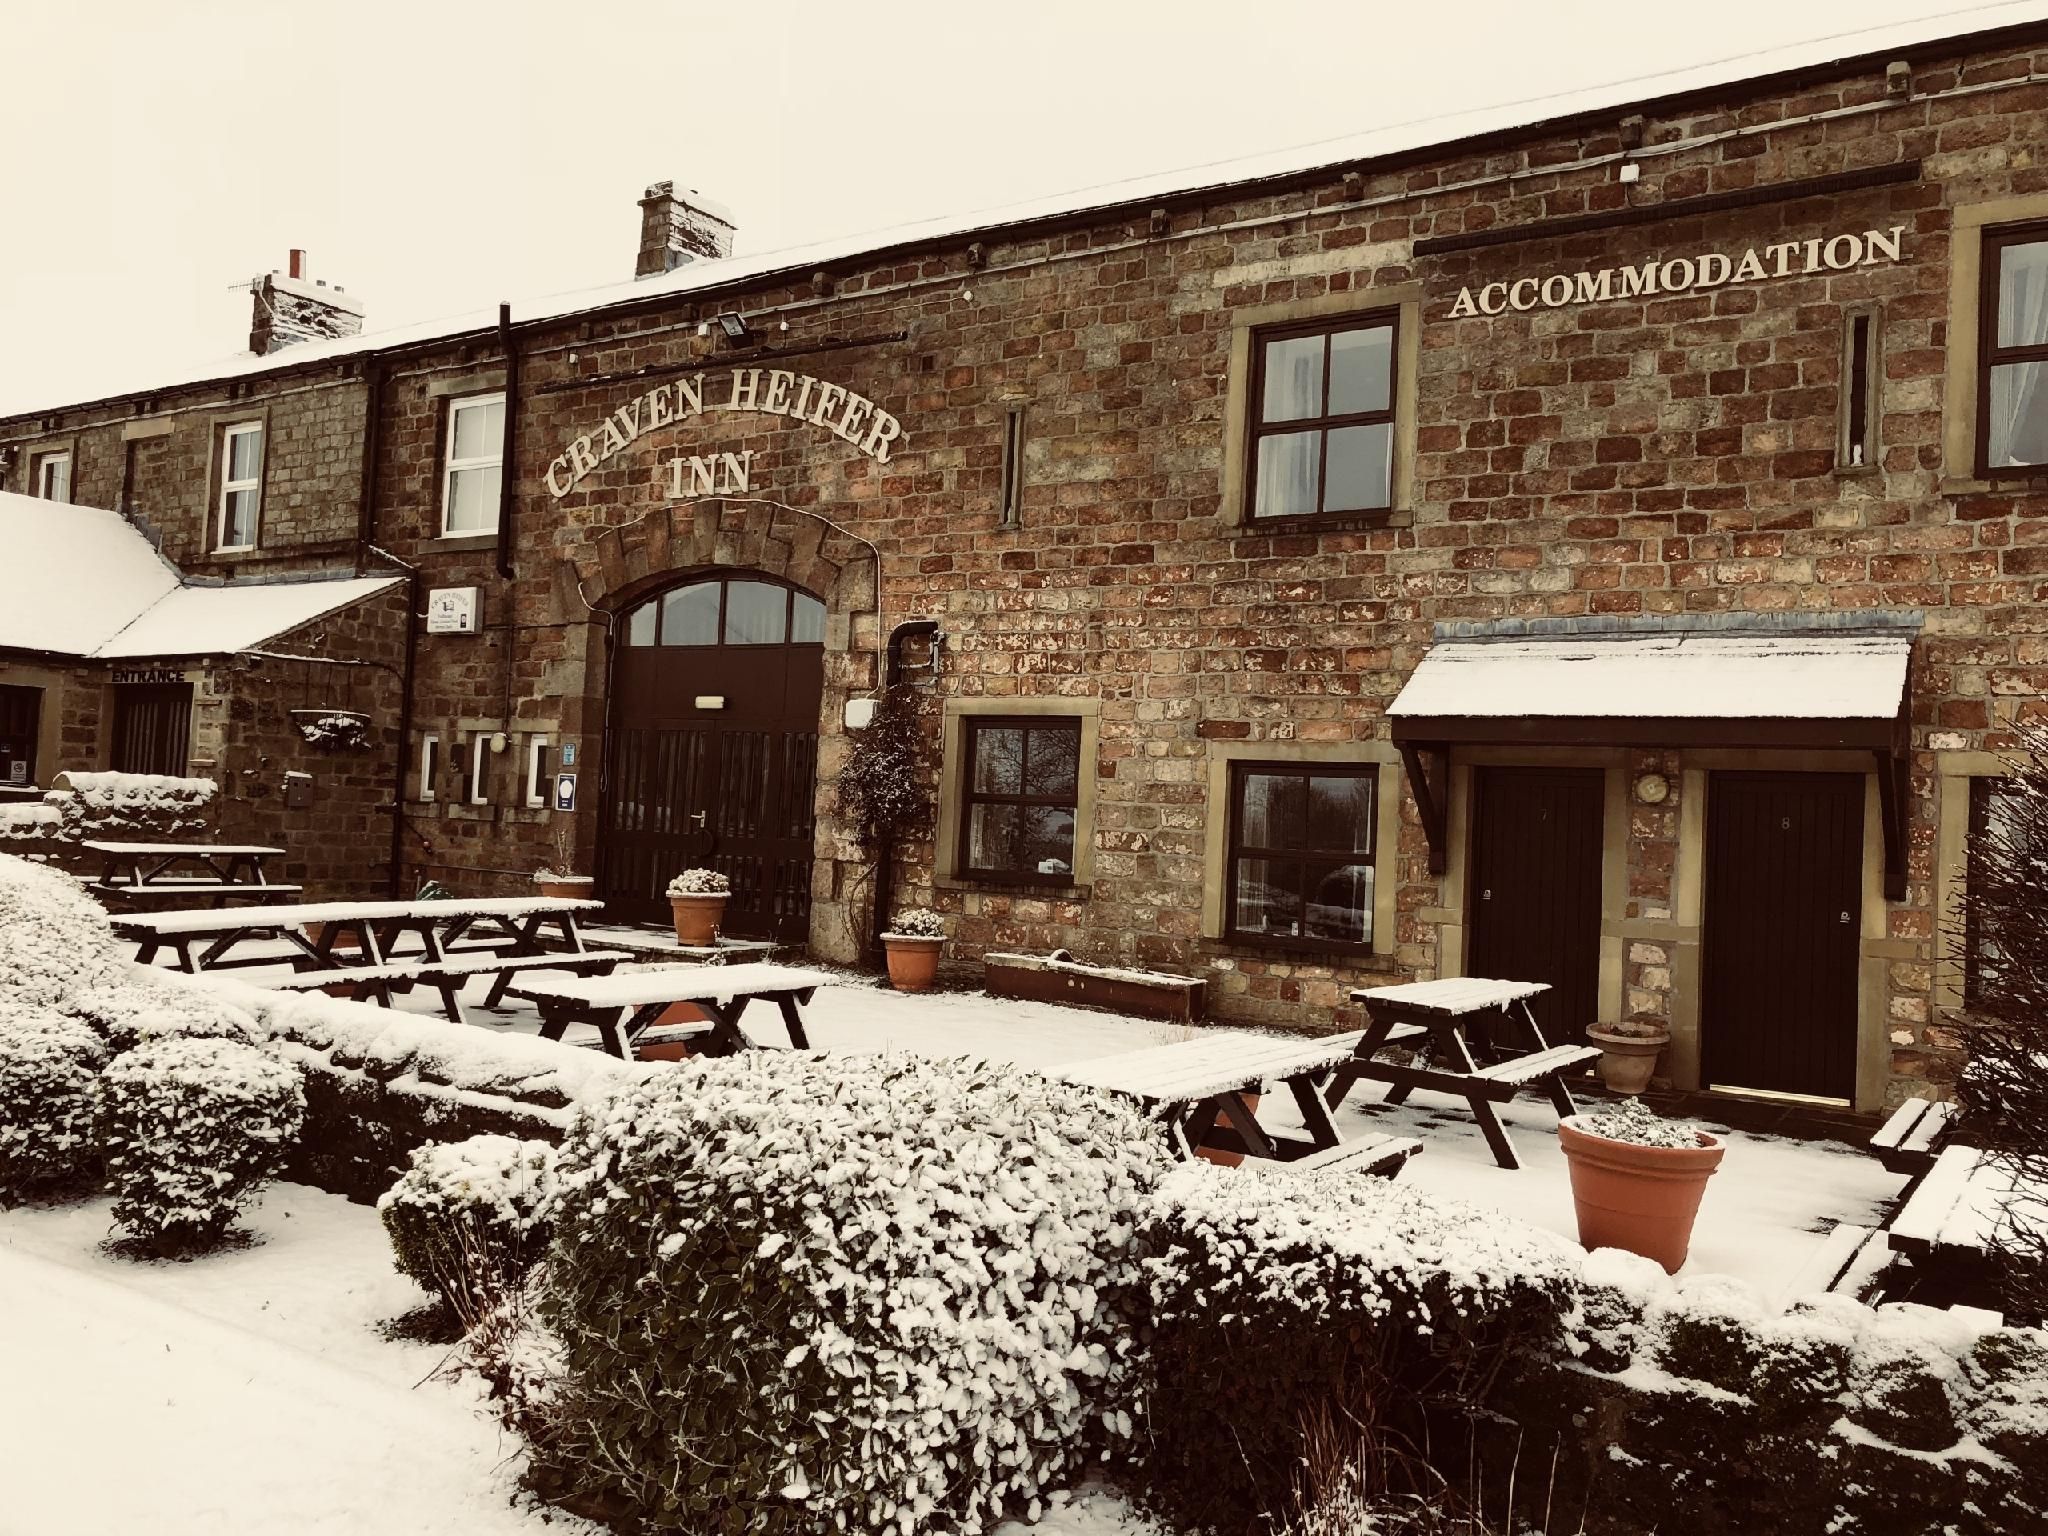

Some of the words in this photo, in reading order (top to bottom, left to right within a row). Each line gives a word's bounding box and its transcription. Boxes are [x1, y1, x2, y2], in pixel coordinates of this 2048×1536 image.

[1442, 226, 1906, 319] ACCOMMODATION
[543, 373, 706, 502] CRAVEN
[724, 368, 903, 463] HEIFER
[668, 449, 756, 500] INN
[111, 670, 185, 682] ENTRANCE
[1782, 816, 1790, 830] 8
